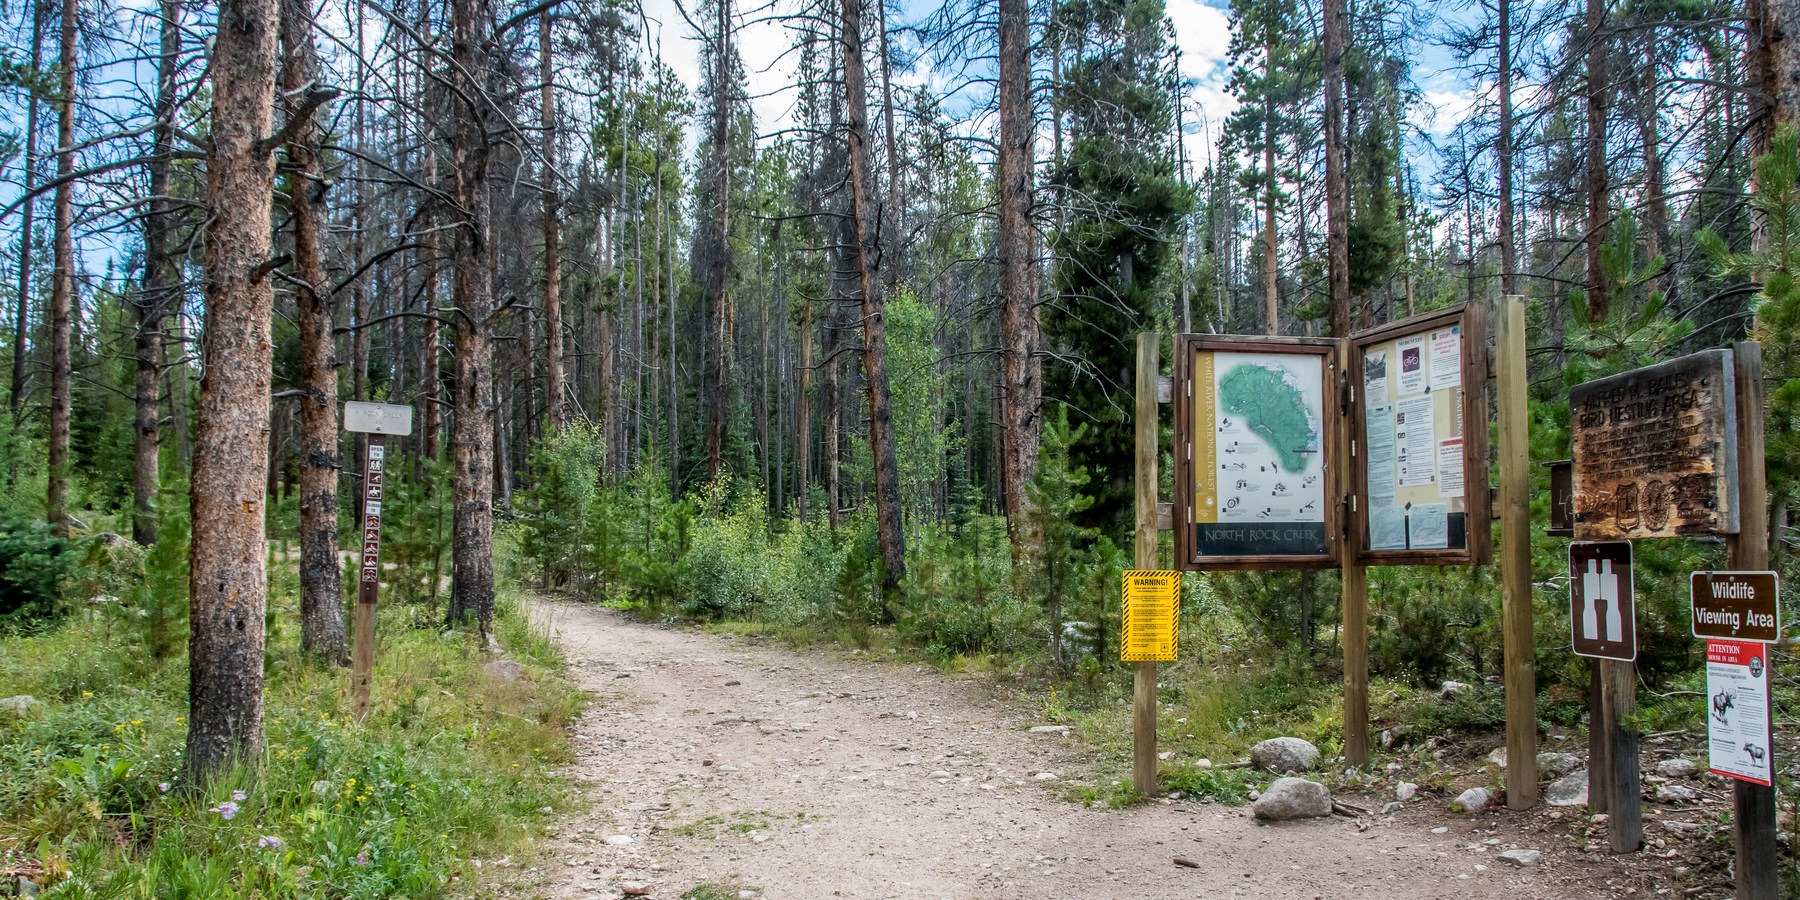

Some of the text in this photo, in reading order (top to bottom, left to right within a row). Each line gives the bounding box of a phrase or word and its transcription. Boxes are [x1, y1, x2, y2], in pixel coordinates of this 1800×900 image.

[1404, 336, 1423, 346] BICYCLES
[1580, 410, 1605, 429] BIRD
[1609, 399, 1658, 426] NESTING
[1662, 389, 1699, 415] AREA
[1207, 461, 1215, 491] FOREST
[1205, 529, 1319, 542] NORTH ROCK CREEK
[1133, 578, 1168, 586] WARNING!
[1711, 581, 1755, 600] Wildlife
[1695, 607, 1774, 630] Viewing Area
[1708, 643, 1741, 655] ATTENTION
[1708, 654, 1721, 662] MOOSE
